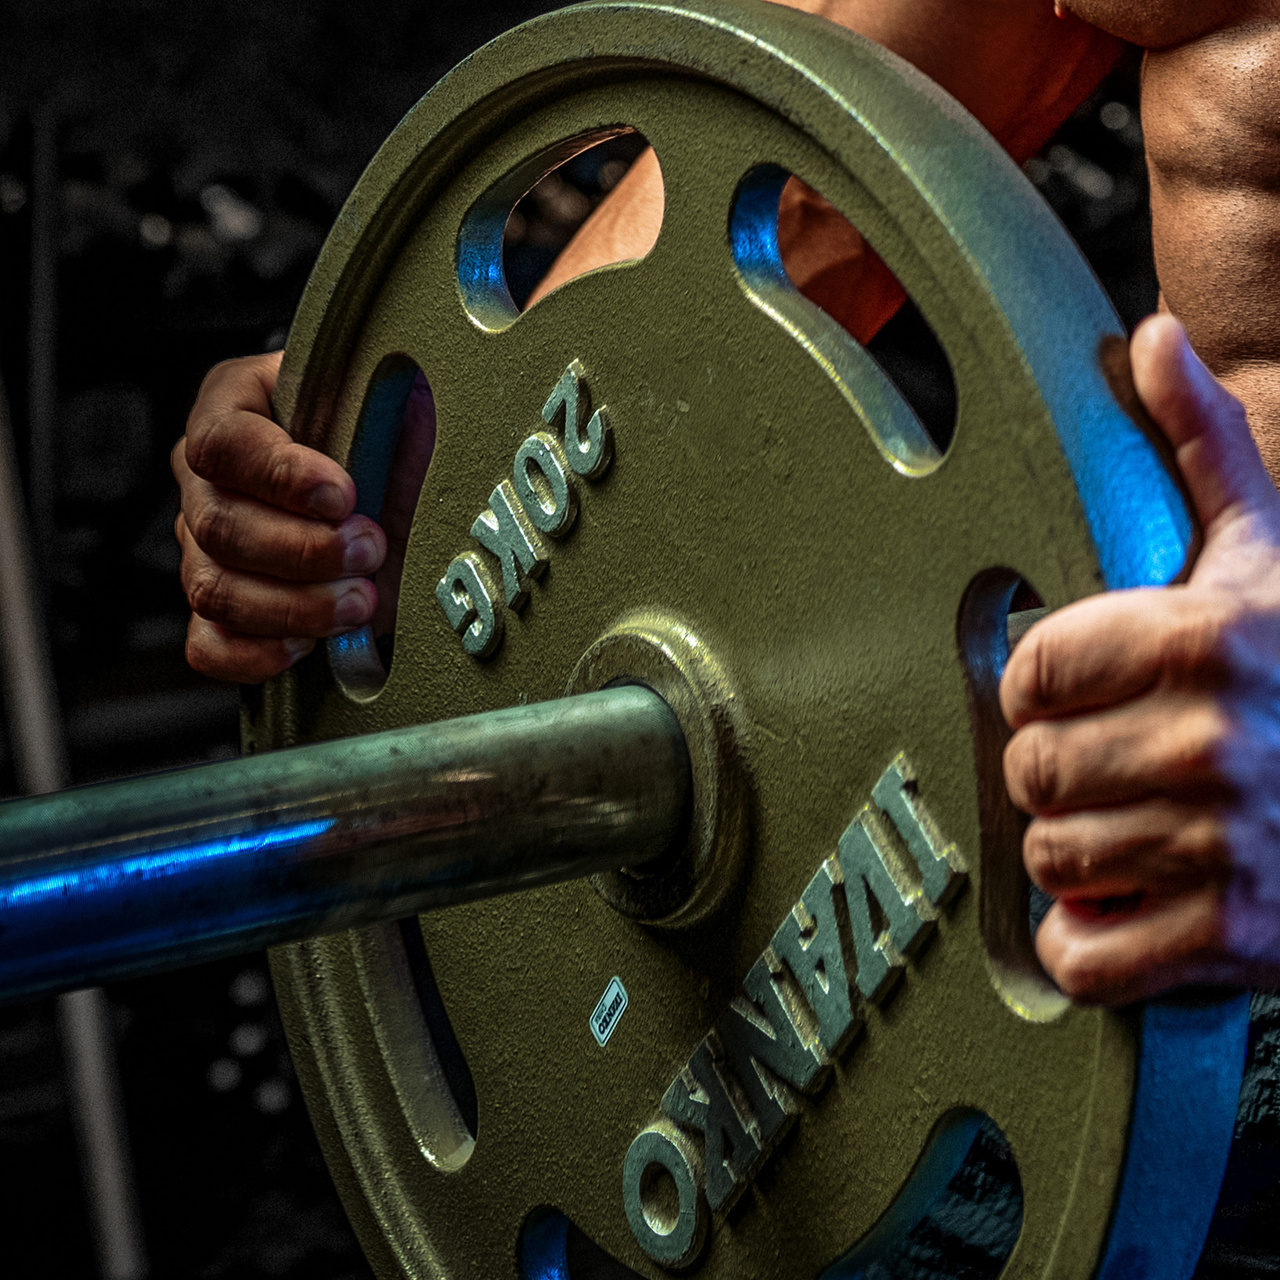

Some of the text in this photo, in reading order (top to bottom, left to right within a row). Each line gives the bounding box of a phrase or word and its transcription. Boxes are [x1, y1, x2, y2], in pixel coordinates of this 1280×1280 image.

[436, 358, 610, 657] 20KG
[599, 991, 623, 1035] IVANKO
[622, 751, 968, 1268] IVANKO
